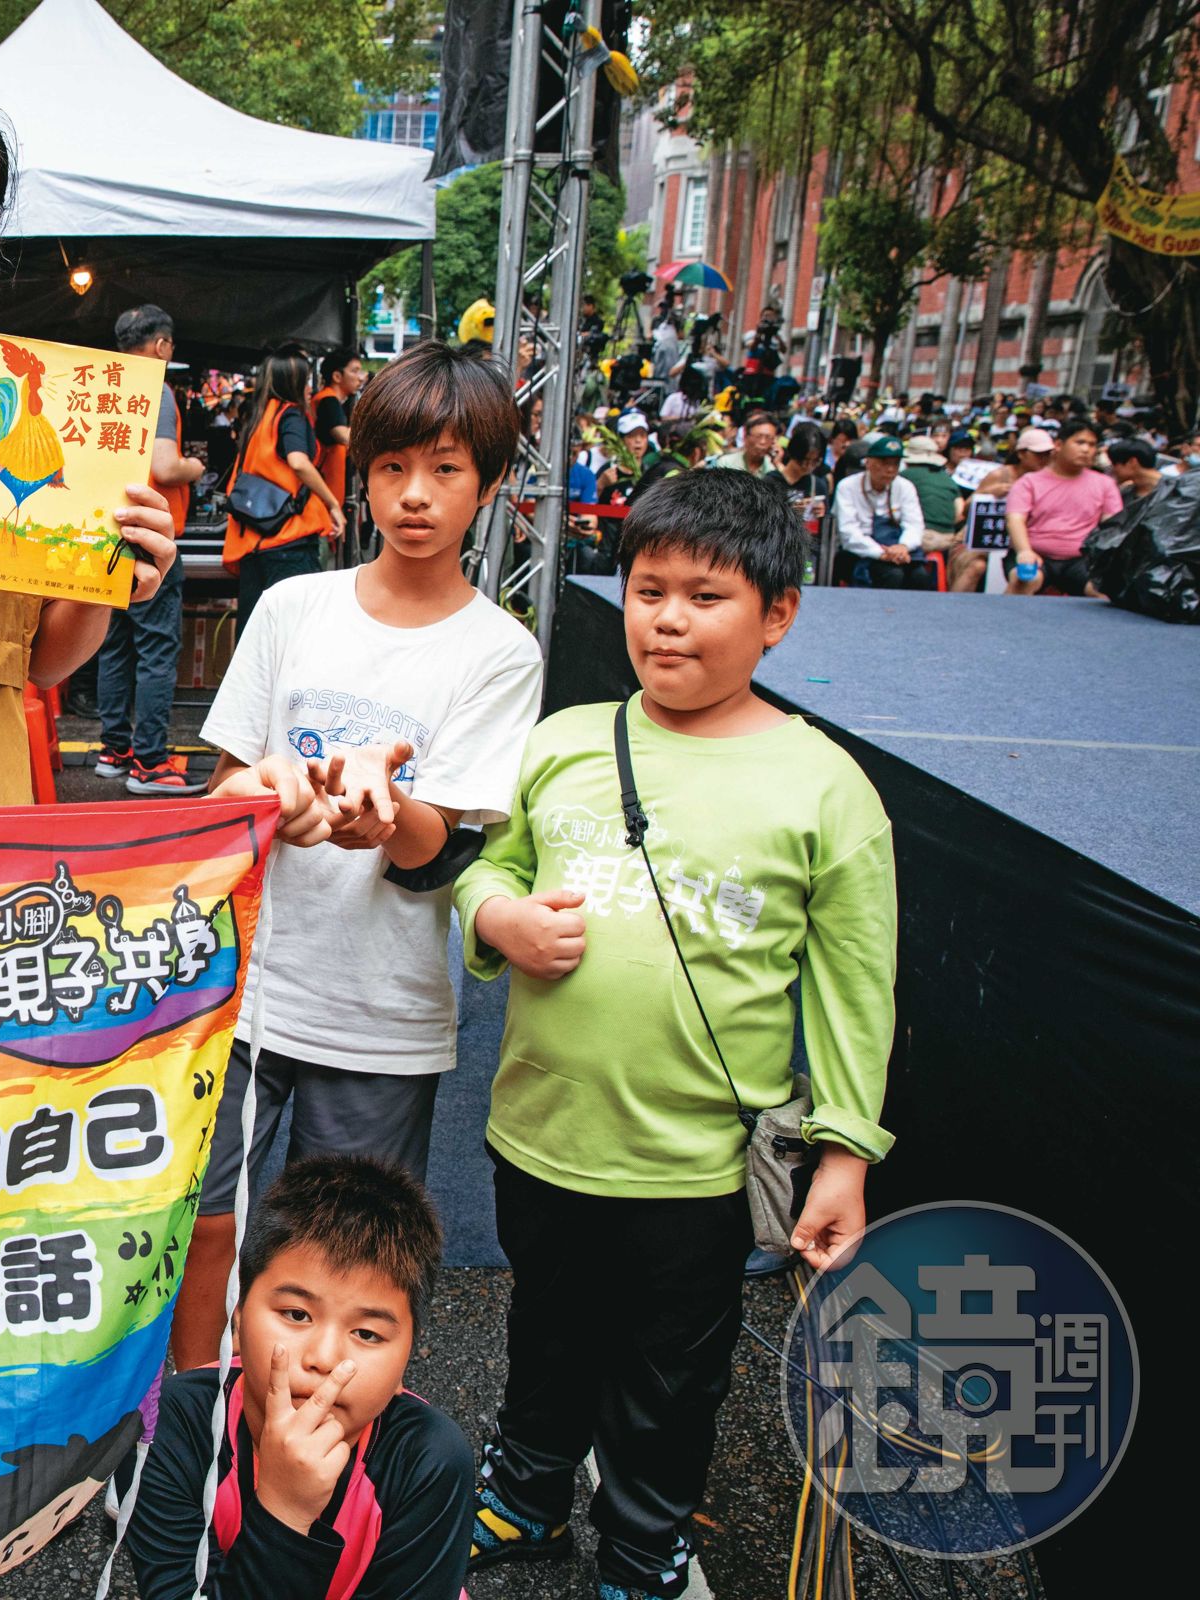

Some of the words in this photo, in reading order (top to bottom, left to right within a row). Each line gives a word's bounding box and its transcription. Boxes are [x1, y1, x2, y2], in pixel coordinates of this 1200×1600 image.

[72, 361, 125, 388] 不肯
[66, 390, 151, 418] 沉默的
[59, 416, 149, 456] 公雞!
[288, 688, 430, 748] PASSIONATE
[562, 853, 766, 949] 親子共學
